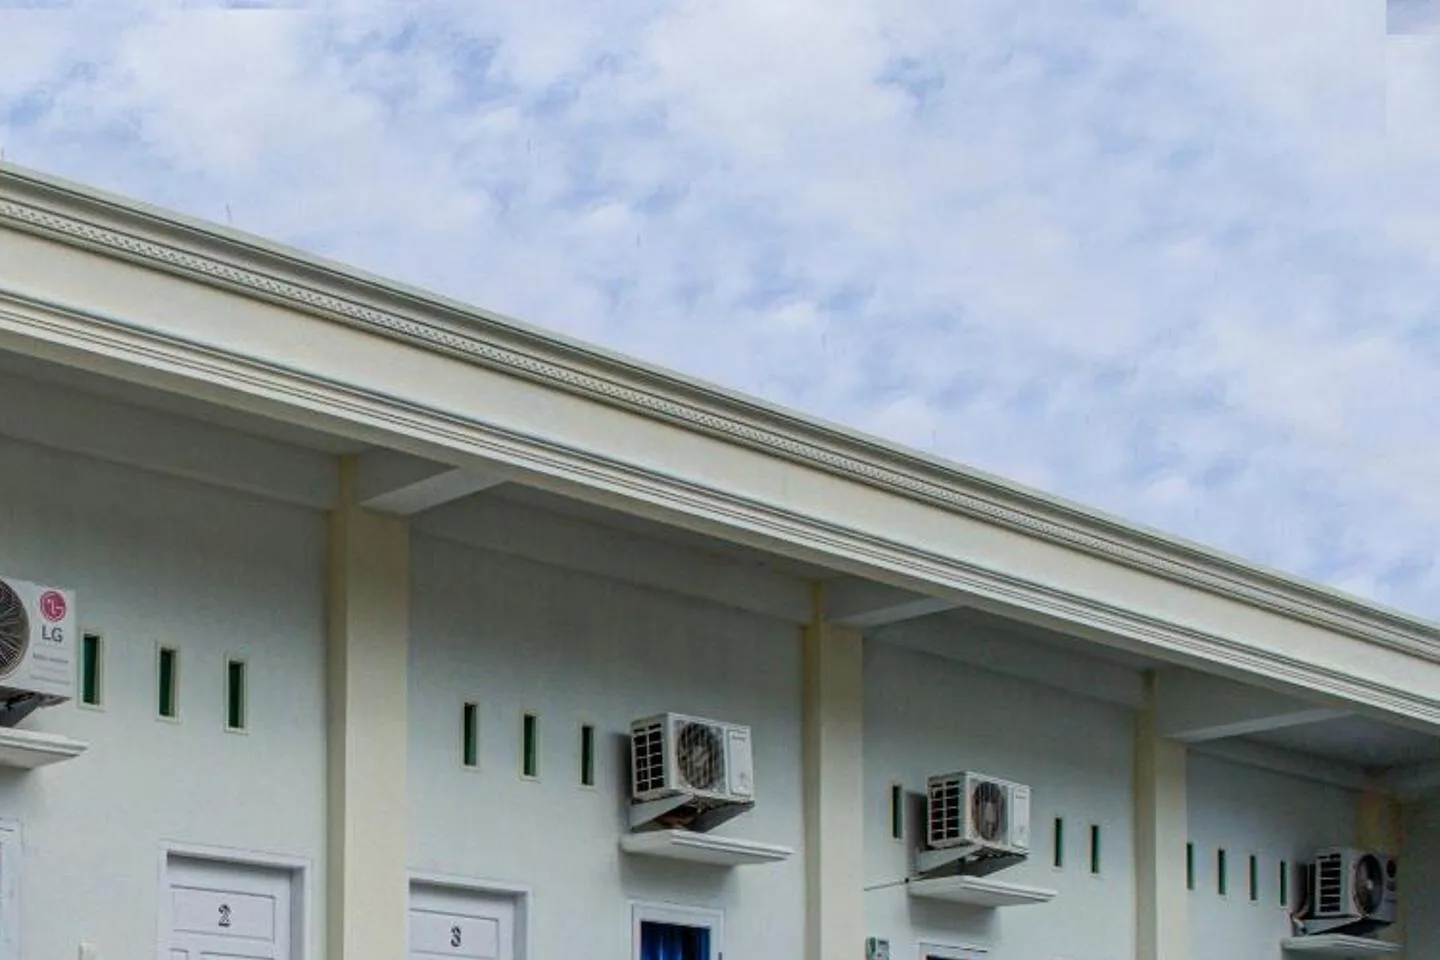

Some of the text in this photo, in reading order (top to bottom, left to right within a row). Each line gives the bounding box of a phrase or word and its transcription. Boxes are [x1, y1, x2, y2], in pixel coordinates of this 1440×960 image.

[41, 624, 64, 643] LG
[218, 903, 232, 928] 2
[450, 925, 462, 948] 3
